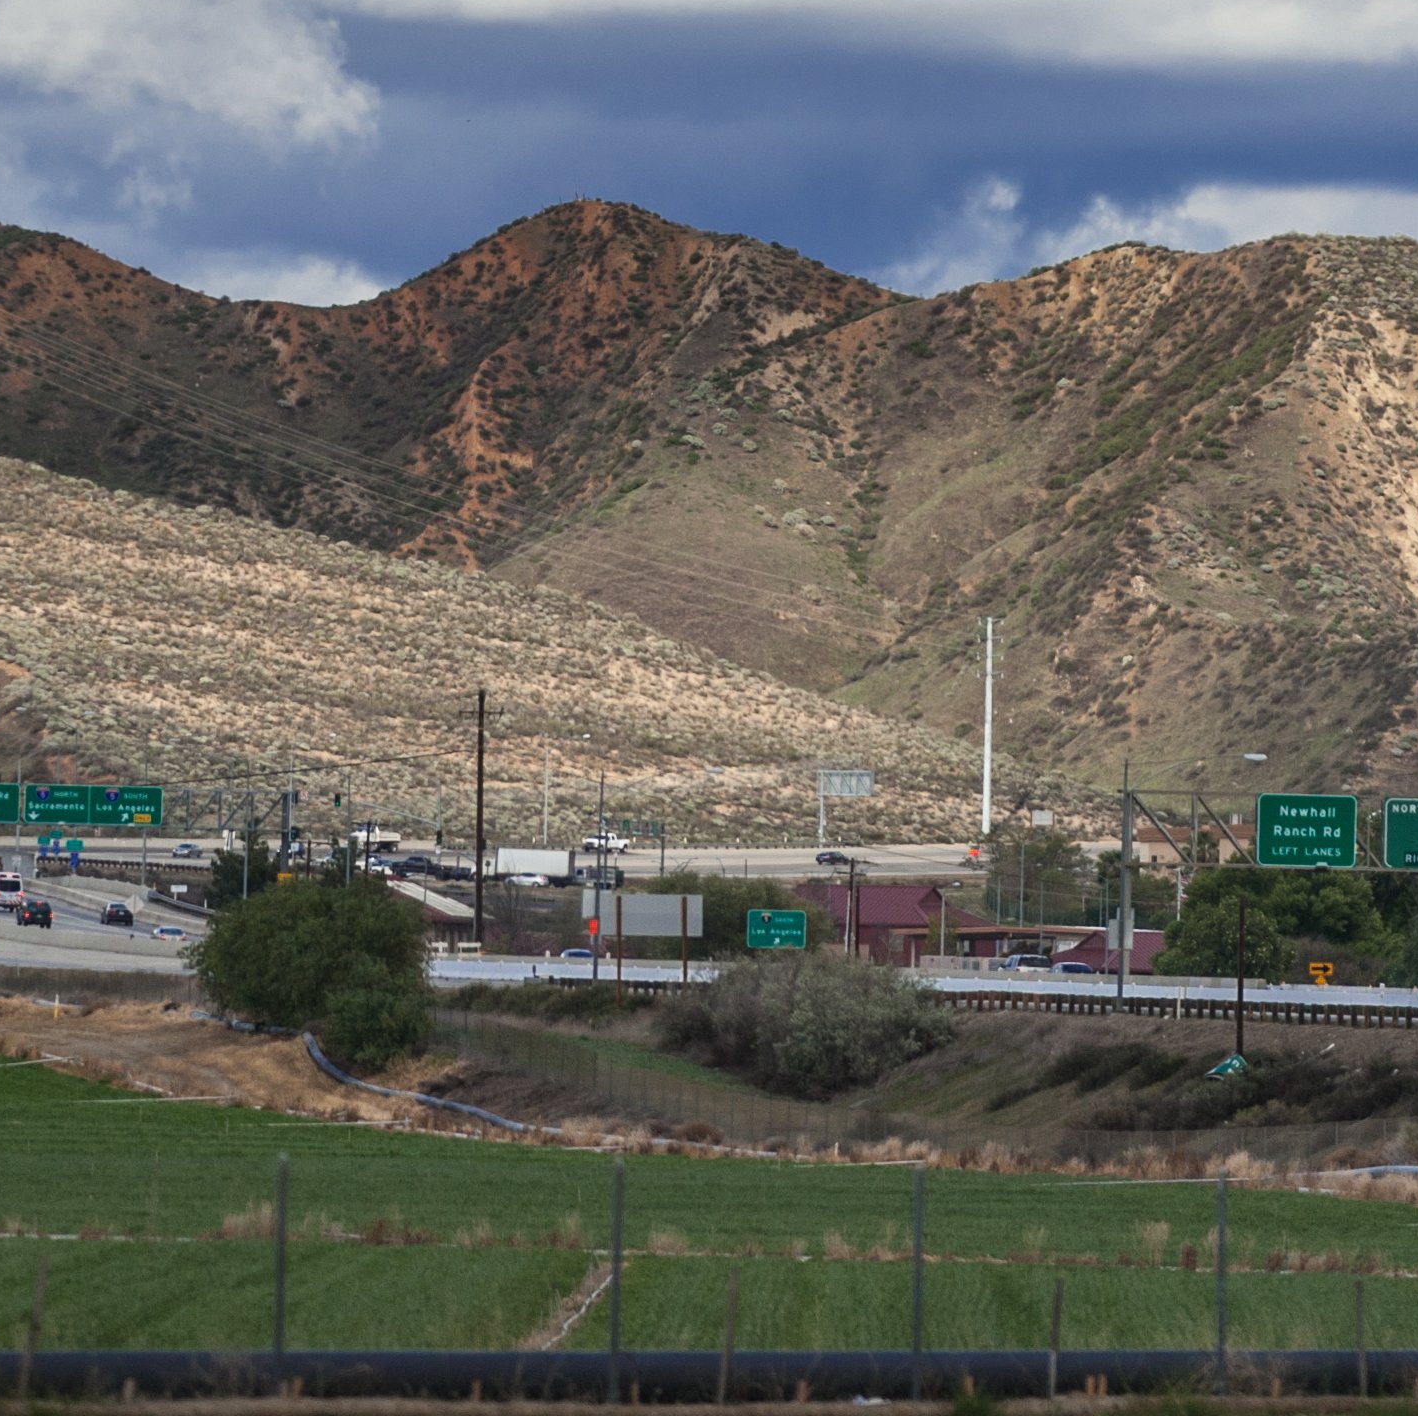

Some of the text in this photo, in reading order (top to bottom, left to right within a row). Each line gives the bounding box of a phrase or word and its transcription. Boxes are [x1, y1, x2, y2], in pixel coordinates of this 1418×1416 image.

[28, 801, 85, 811] Sacramento
[95, 804, 155, 813] Los Angeles
[1279, 805, 1336, 818] Newhall
[1273, 824, 1341, 838] Ranch Rd
[1271, 846, 1341, 857] LEFT LANES
